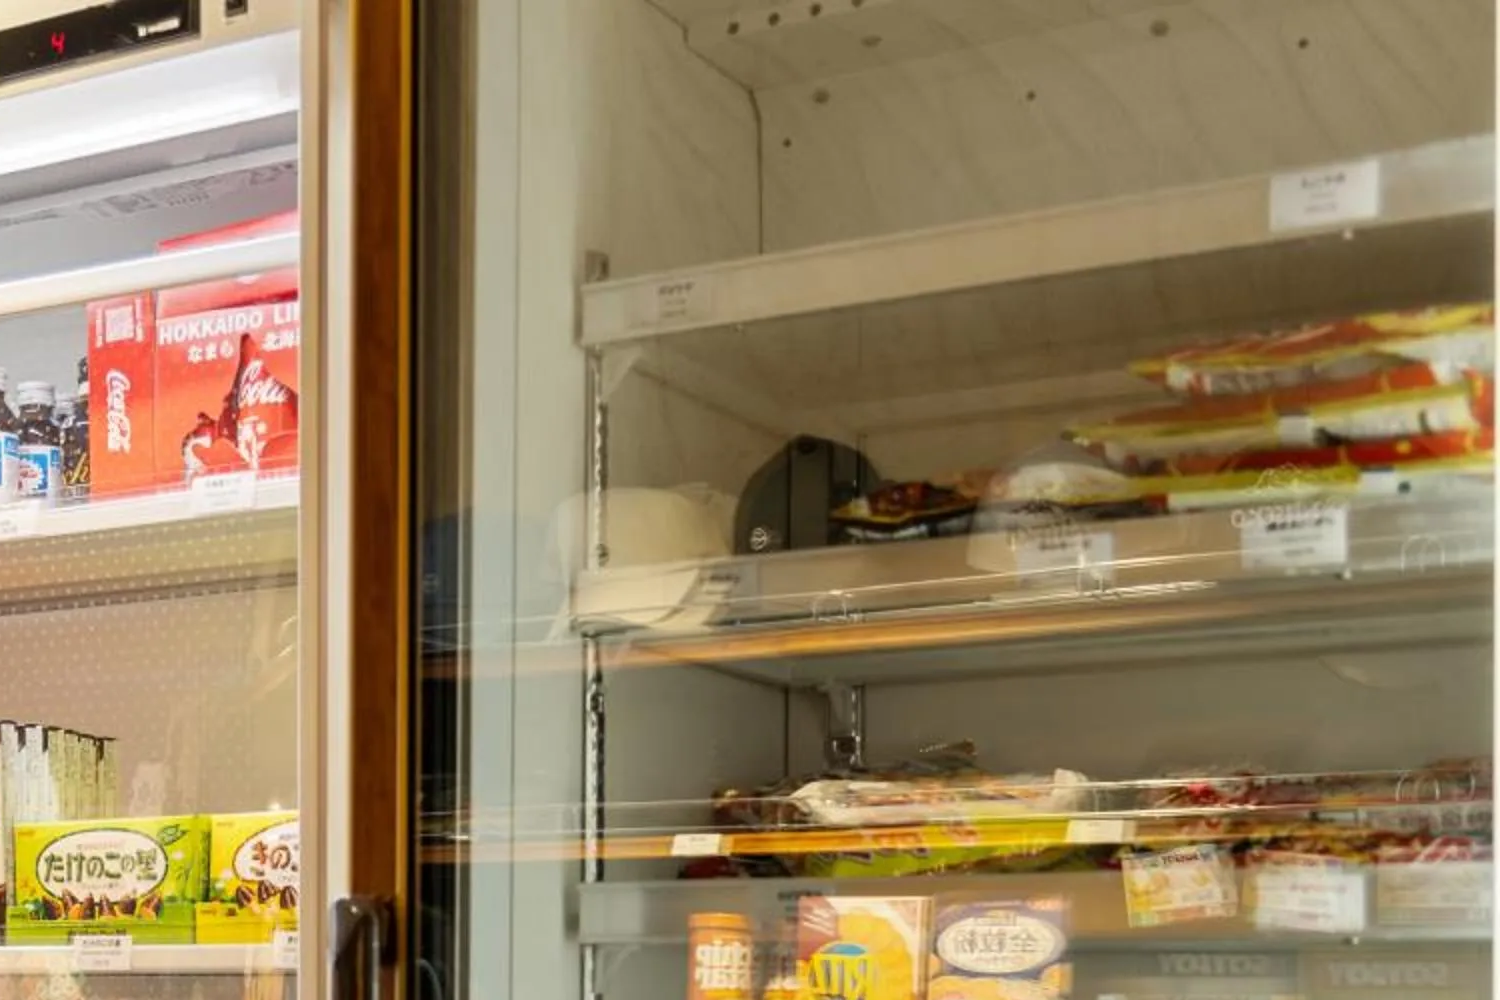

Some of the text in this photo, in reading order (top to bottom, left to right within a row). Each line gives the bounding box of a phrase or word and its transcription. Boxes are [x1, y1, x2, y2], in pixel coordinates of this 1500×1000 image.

[51, 33, 65, 54] 4
[159, 303, 298, 345] HOKKAIDO LI
[43, 849, 158, 883] たけのこの里
[250, 840, 298, 878] きの
